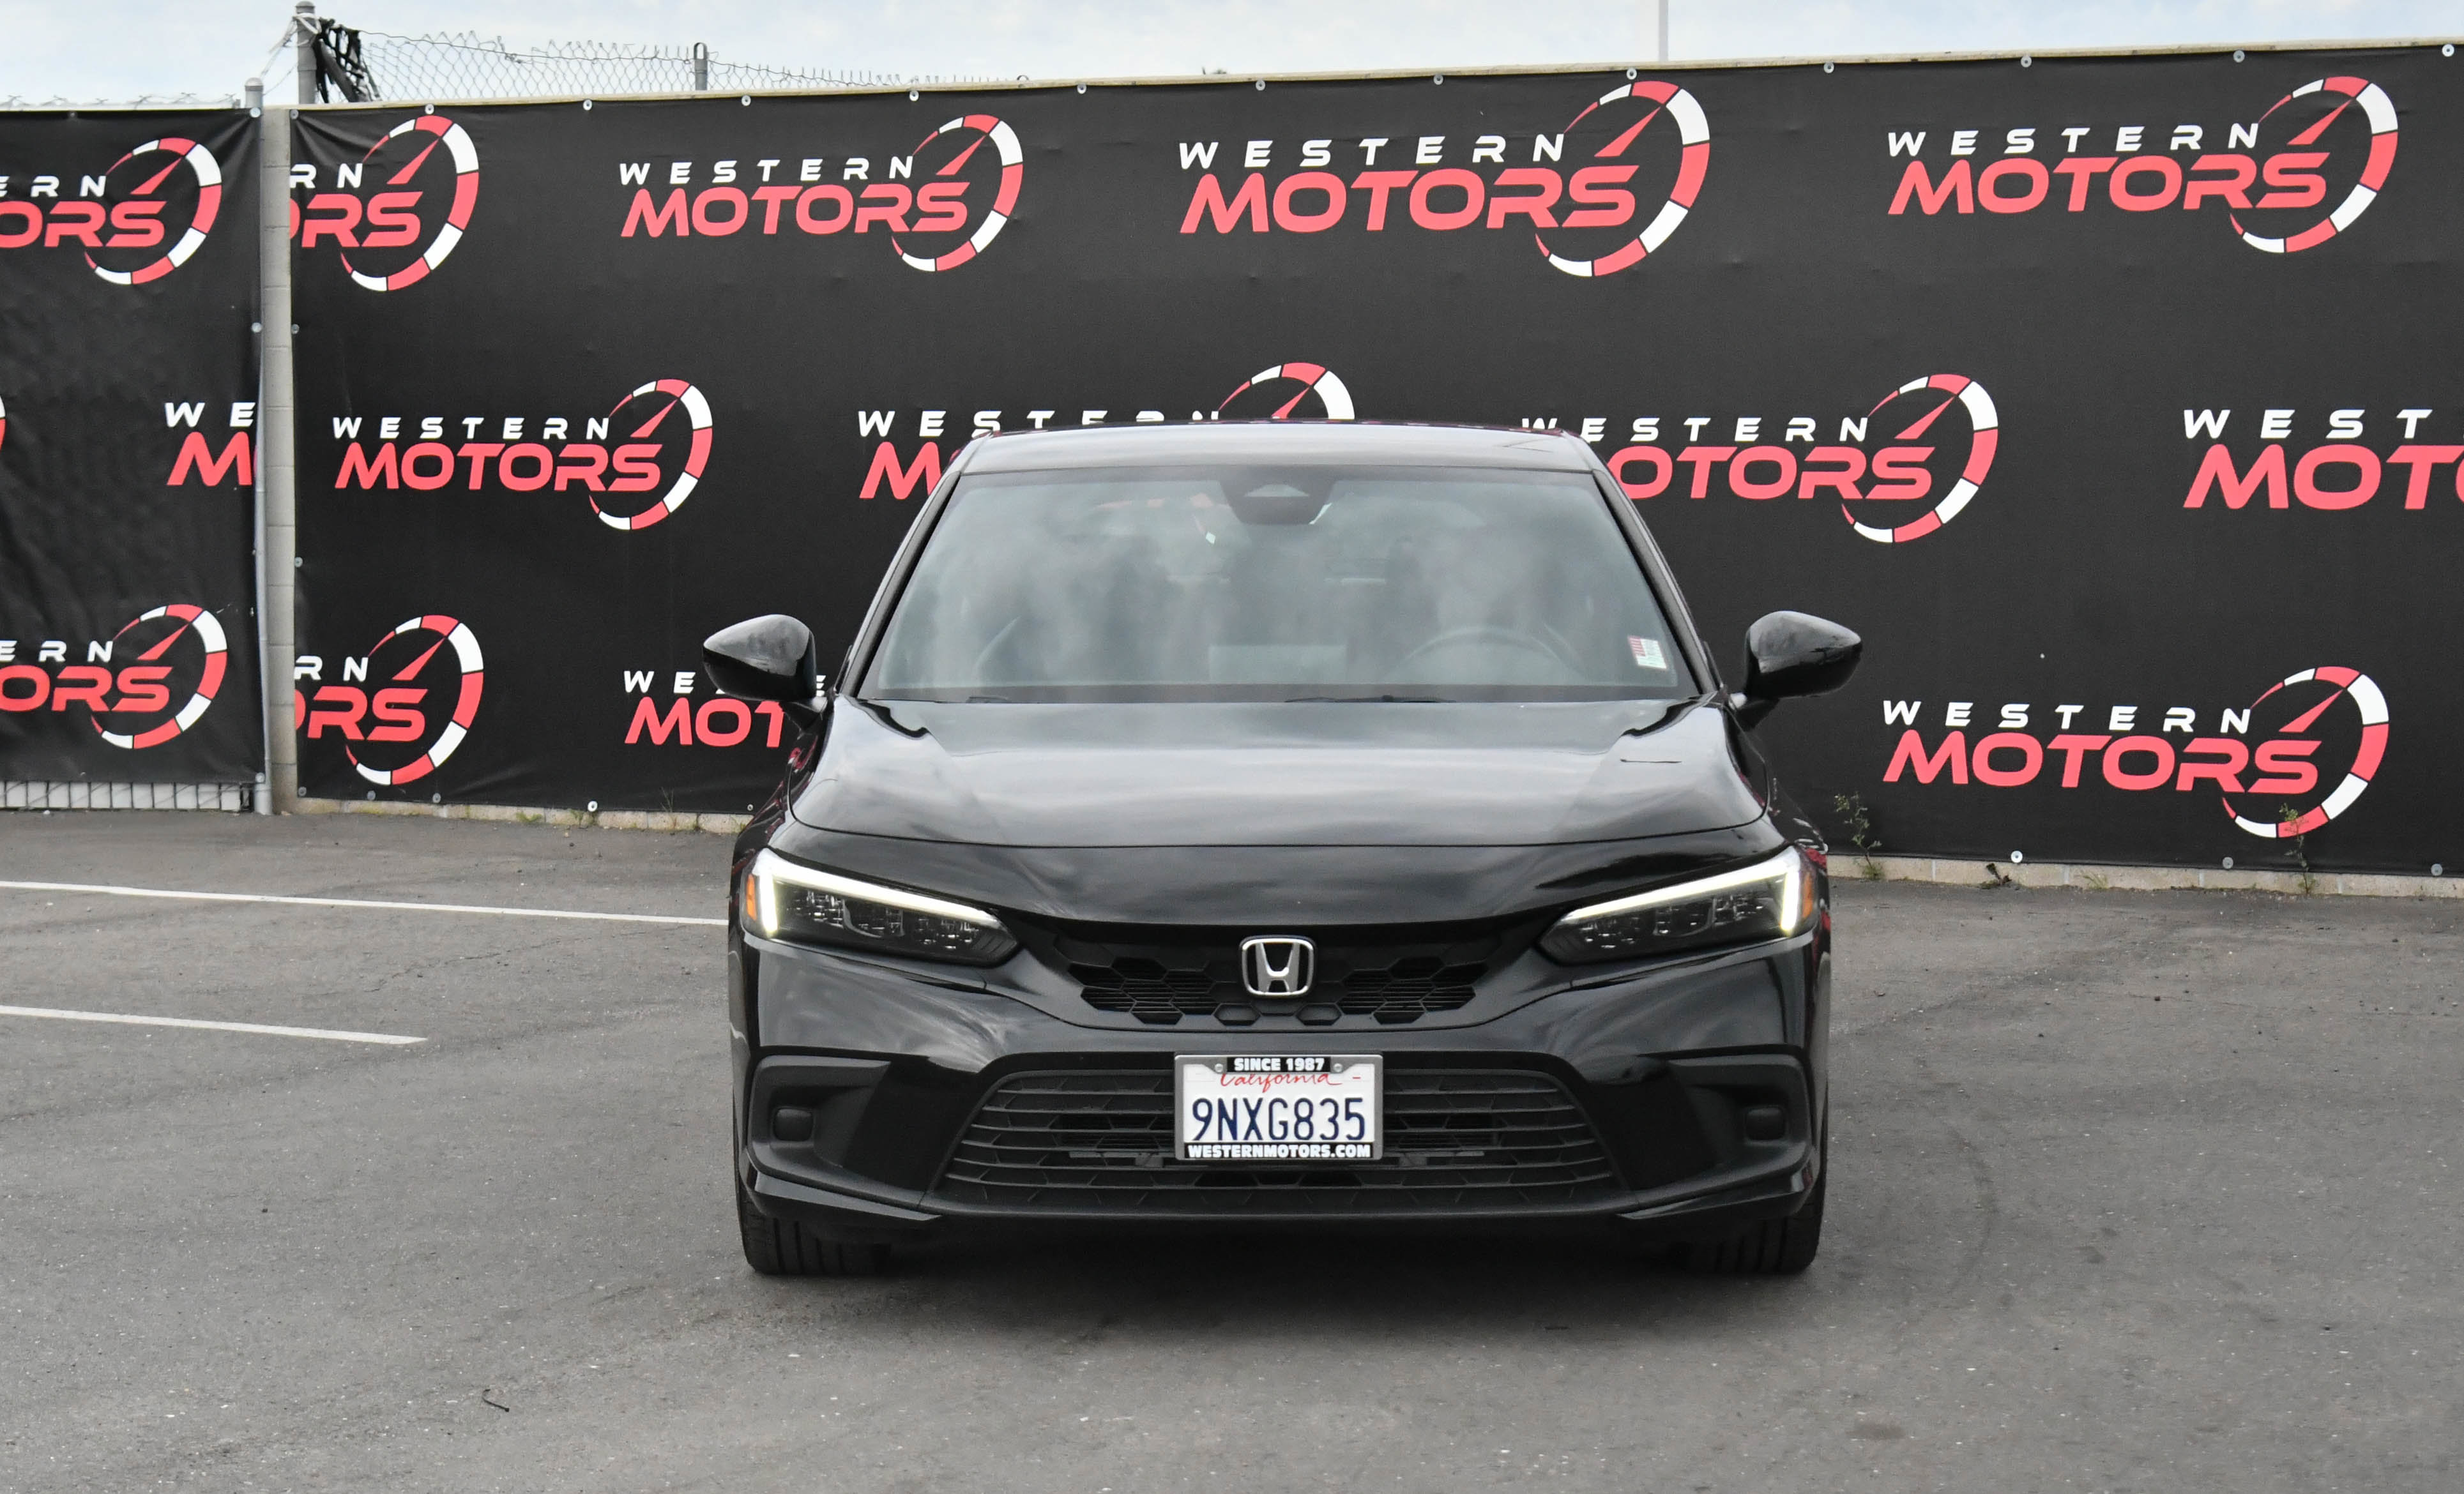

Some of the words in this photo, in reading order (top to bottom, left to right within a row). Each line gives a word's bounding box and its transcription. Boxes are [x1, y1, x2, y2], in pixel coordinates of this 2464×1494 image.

[1179, 133, 1564, 170] WESTERN
[1888, 123, 2259, 157] WESTERN
[289, 162, 363, 189] RN
[620, 156, 913, 185] WESTERN
[1888, 151, 2331, 215] MOTORS
[621, 181, 970, 238] MOTORS
[1180, 165, 1639, 234] MOTORS
[333, 417, 609, 440] WESTERN
[2184, 409, 2433, 439] WEST
[167, 431, 257, 487] M
[334, 442, 663, 492] MOTORS
[859, 441, 961, 500] M
[2183, 444, 2464, 511] MOT
[294, 655, 369, 682] RN
[0, 665, 173, 713] ORS
[1883, 699, 2251, 735] WESTERN
[1883, 728, 2322, 795] MOTORS
[1234, 1057, 1281, 1071] SINCE
[1286, 1057, 1325, 1071] 1987
[1220, 1073, 1342, 1093] California
[1192, 1097, 1365, 1141] 9NXG835
[1187, 1145, 1371, 1158] WESTERNMOTORS.COM
